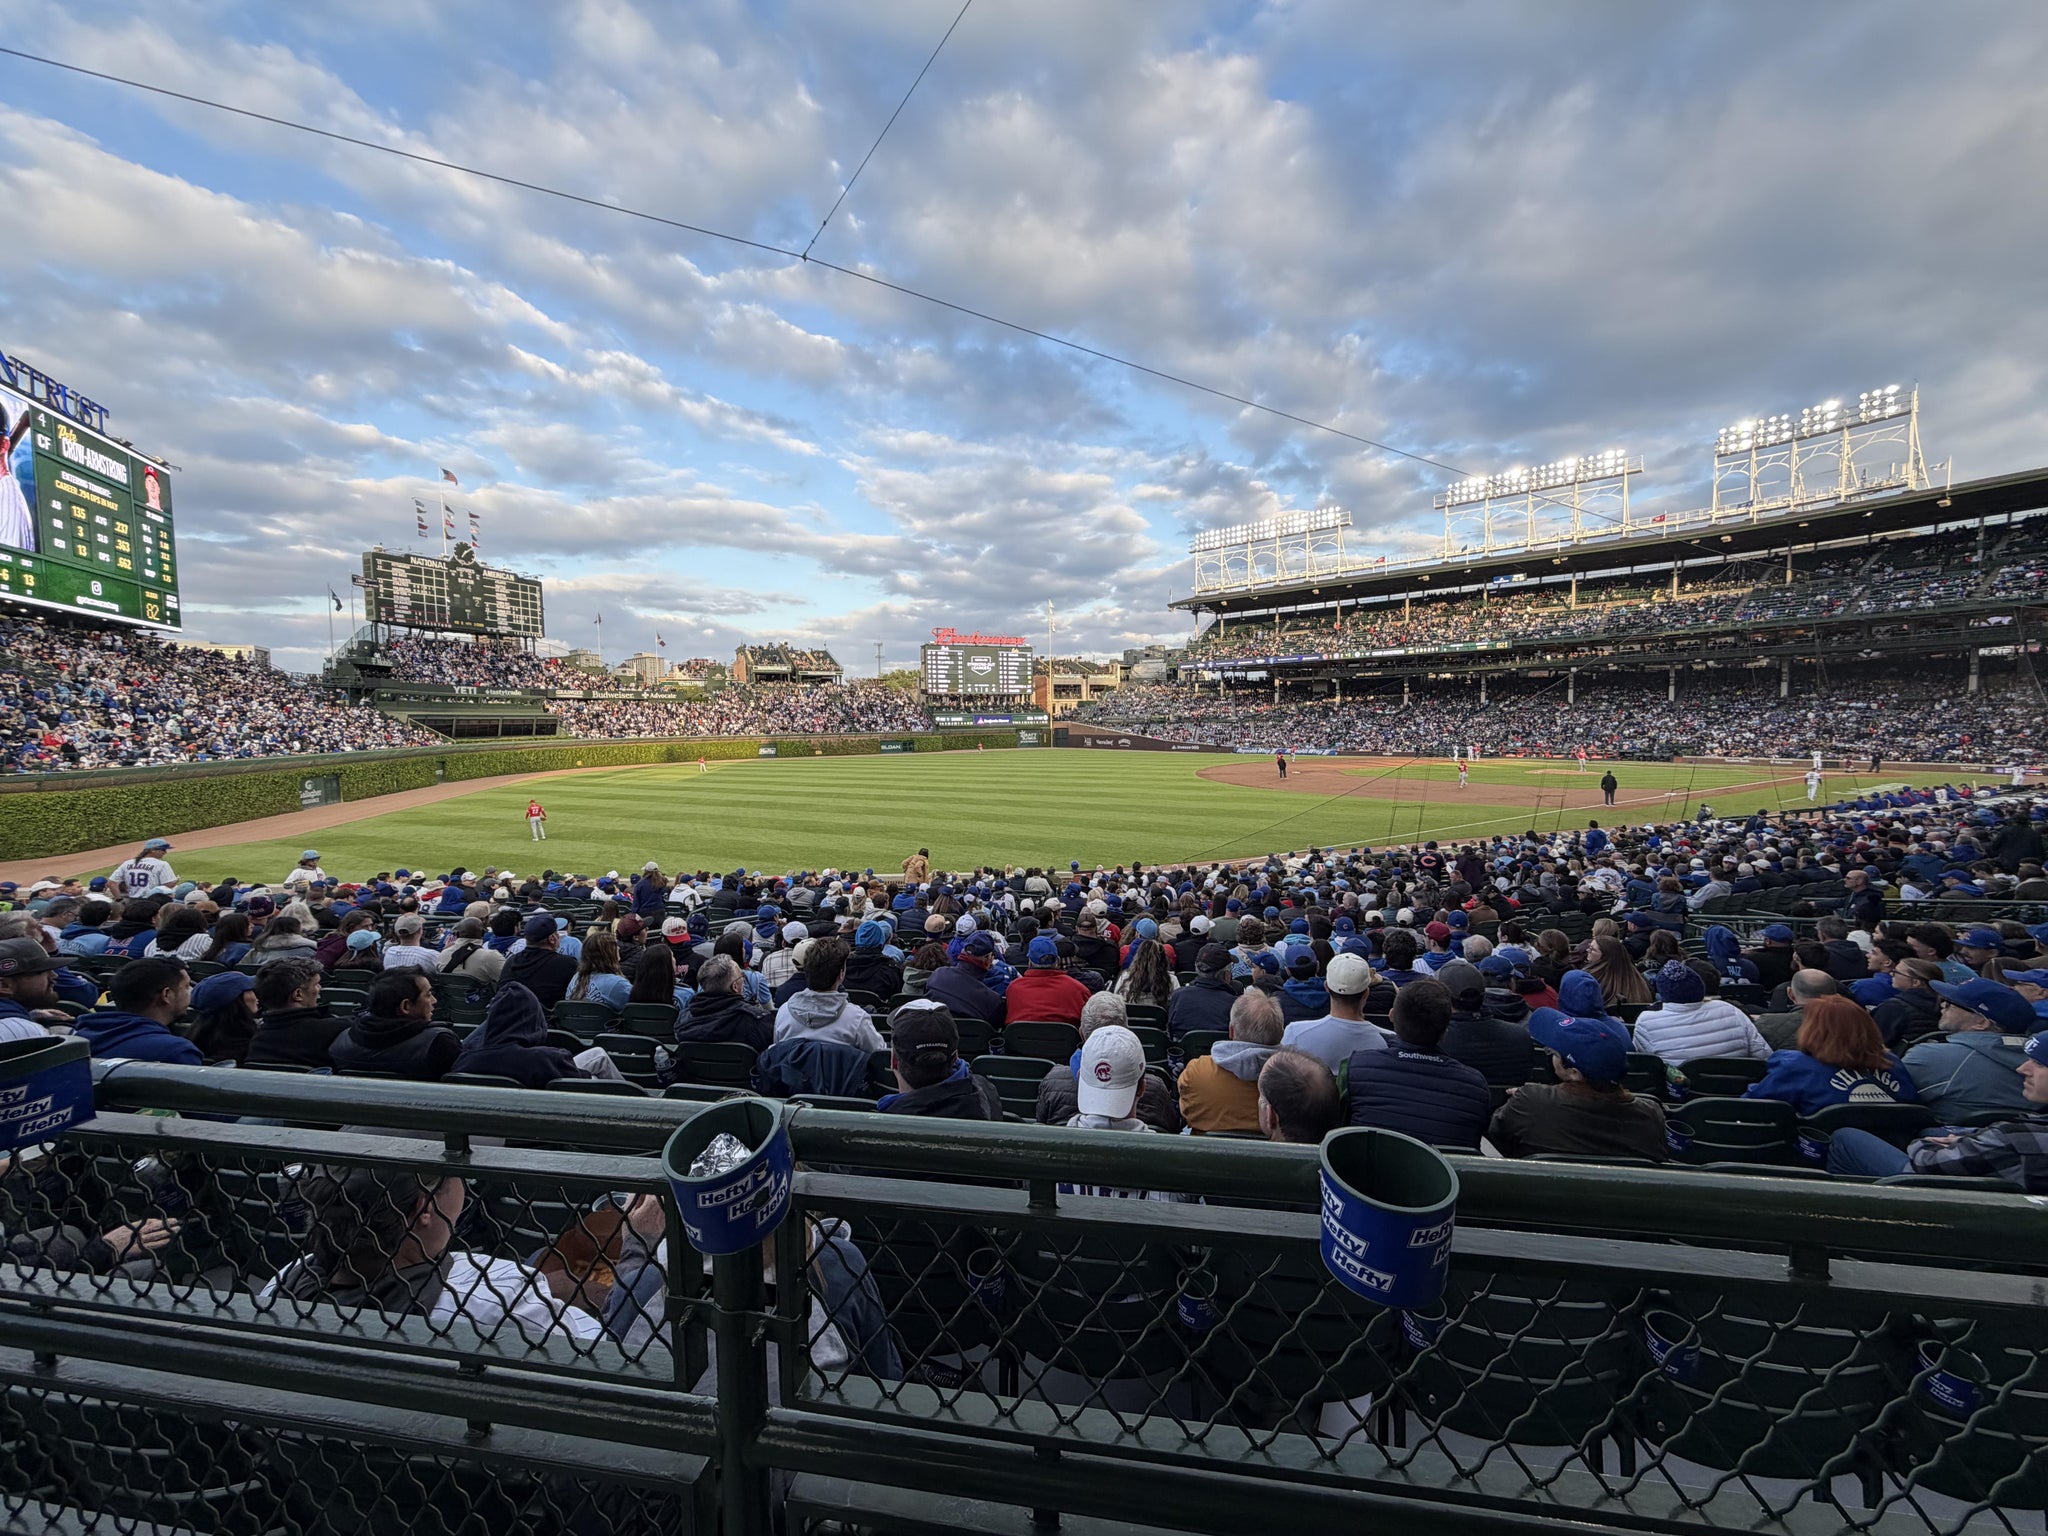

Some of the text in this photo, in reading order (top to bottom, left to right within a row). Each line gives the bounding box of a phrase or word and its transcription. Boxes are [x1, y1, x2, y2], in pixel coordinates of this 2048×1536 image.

[38, 413, 46, 427] 4
[37, 433, 51, 450] CF
[57, 424, 78, 443] Pete
[61, 436, 127, 484] CROW-ARMSTRONG
[71, 505, 86, 520] 135
[77, 525, 84, 538] 3
[77, 544, 87, 557] 13
[410, 556, 448, 570] NATIONAL
[23, 573, 35, 587] 13
[482, 569, 515, 581] AMERICAN
[146, 603, 160, 620] 82
[453, 686, 477, 695] YETI
[592, 690, 634, 699] Budweiser
[129, 872, 149, 887] 18
[1398, 1051, 1441, 1063] Southwest
[1829, 1068, 1900, 1093] CHIAGO
[21, 1110, 70, 1135] Hefty
[700, 1178, 749, 1206] Hefty
[759, 1182, 787, 1223] Hefty
[1322, 1208, 1361, 1253] Hefty
[1413, 1222, 1450, 1245] Heft
[1333, 1249, 1389, 1291] Hefty
